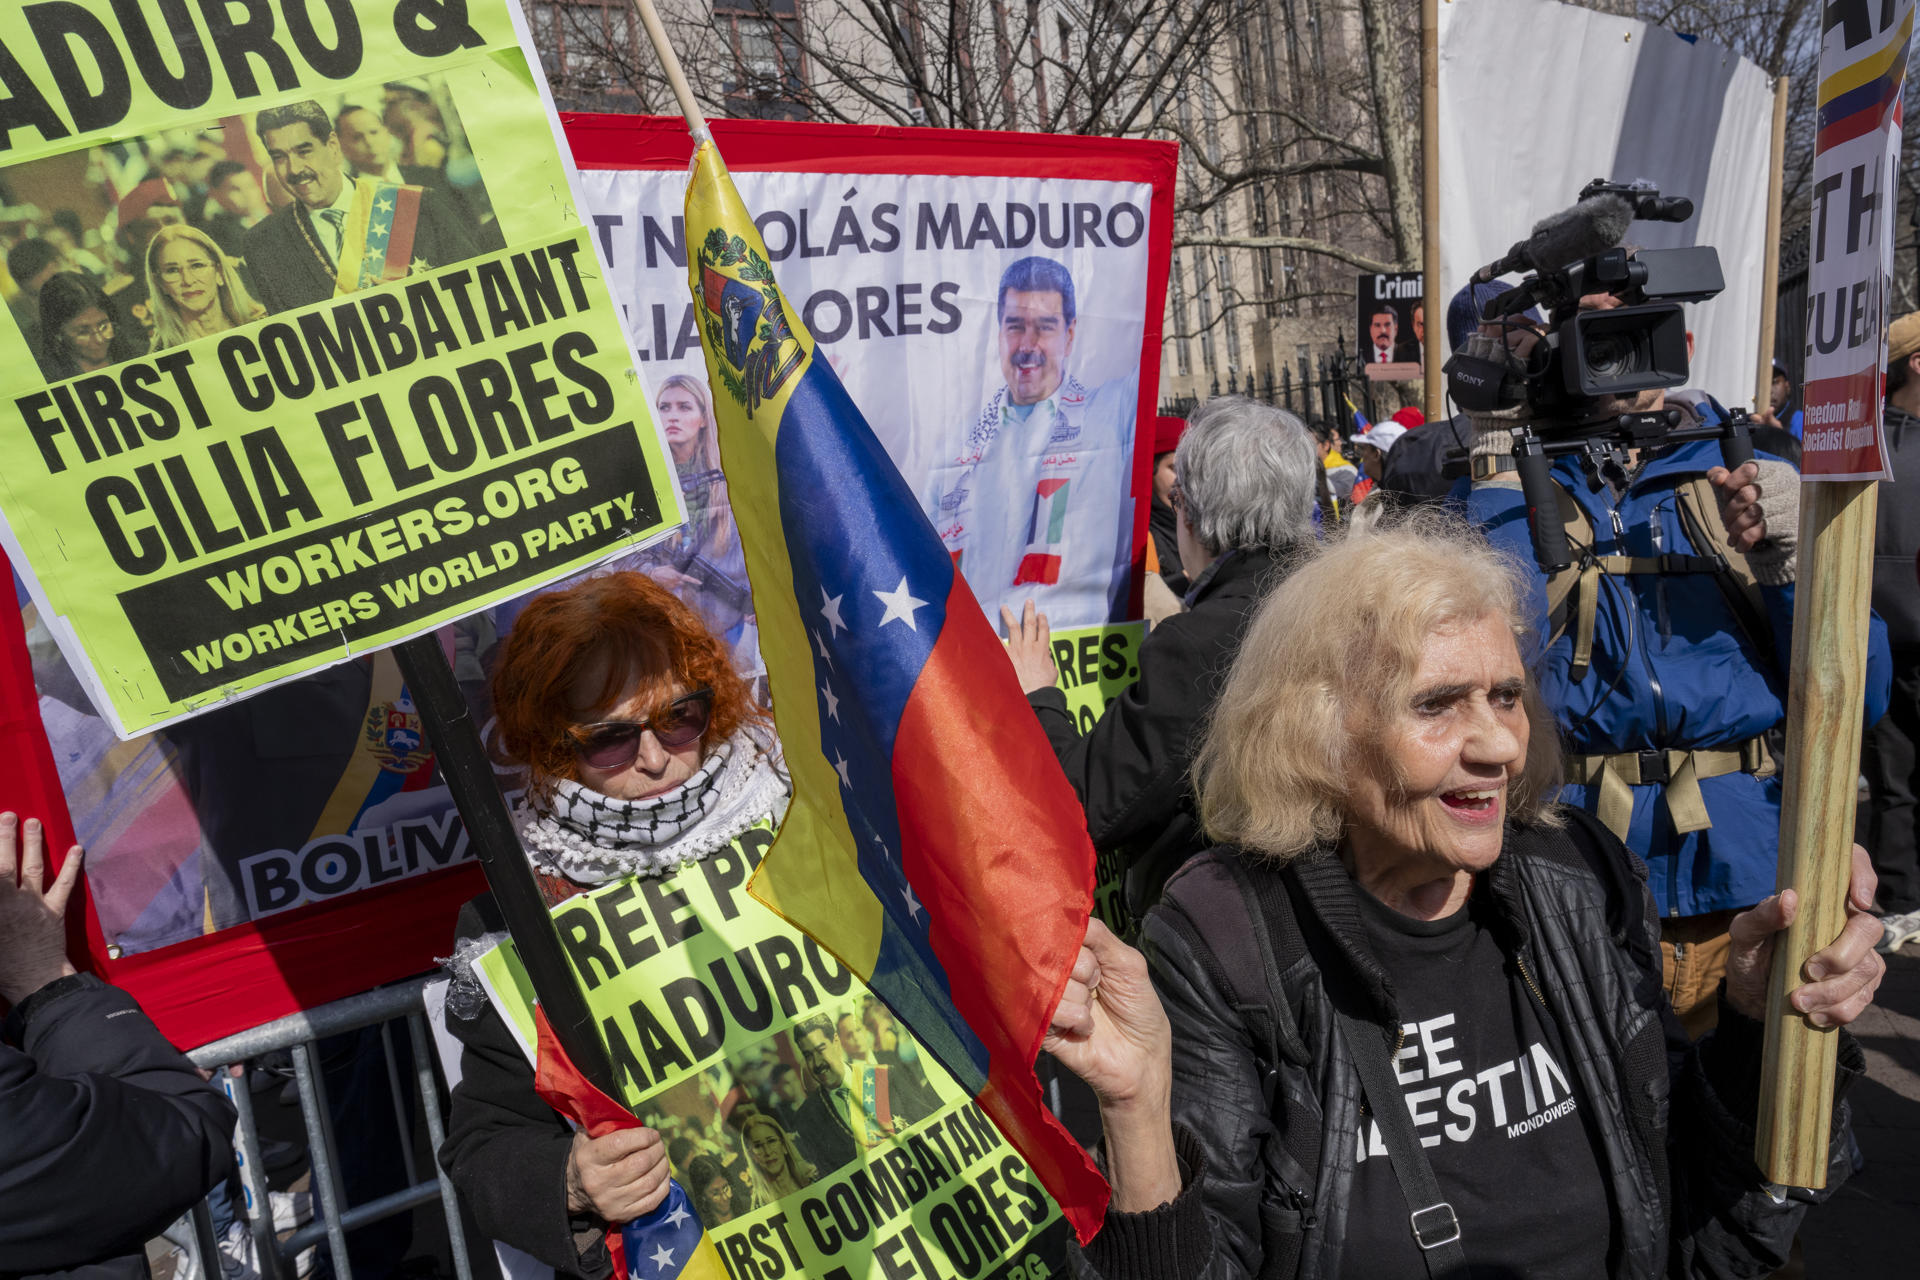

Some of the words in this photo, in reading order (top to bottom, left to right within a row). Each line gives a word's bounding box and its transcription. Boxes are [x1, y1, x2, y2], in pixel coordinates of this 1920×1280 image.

[0, 0, 364, 151] ADURO
[643, 186, 901, 268] NOLÁS
[915, 201, 1145, 251] MADURO
[802, 281, 963, 344] ORES
[1374, 274, 1423, 300] Crimi
[15, 349, 213, 475] FIRST
[217, 239, 591, 413] COMBATANT
[1457, 371, 1485, 387] SONY
[84, 426, 324, 576] CILIA
[315, 331, 616, 507] FLORES
[1803, 427, 1844, 452] Socialist
[1804, 401, 1846, 425] Freedom
[206, 456, 589, 611] WORKERS.ORG
[181, 591, 381, 675] WORKERS
[381, 541, 519, 610] WORLD
[521, 491, 635, 559] PARTY
[1052, 633, 1138, 690] RES.
[251, 815, 478, 913] BOLIV
[553, 868, 703, 991] REE
[1391, 1013, 1463, 1086] EE
[714, 1211, 804, 1280] IRST
[801, 1101, 1001, 1256] COMBATAN
